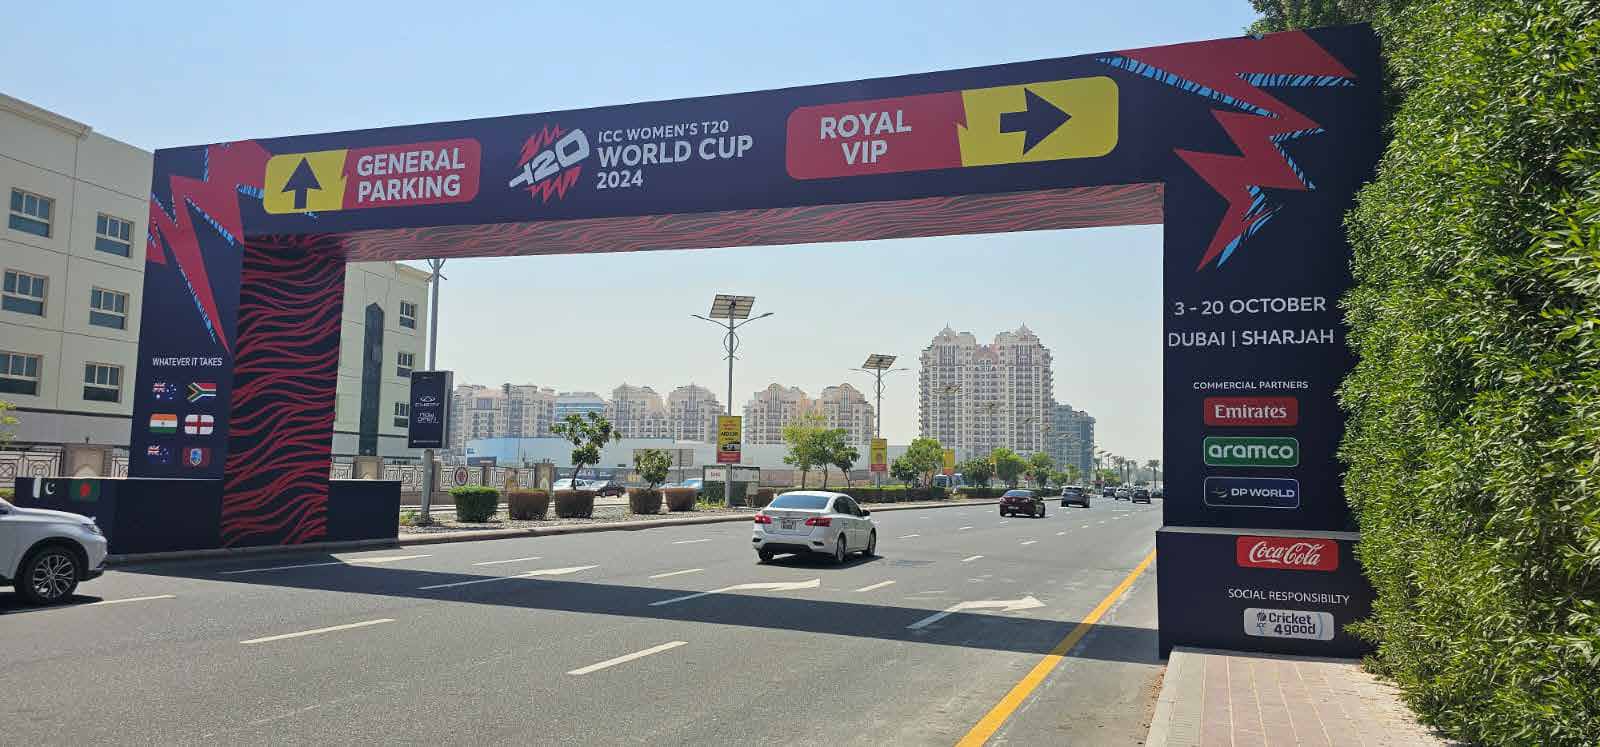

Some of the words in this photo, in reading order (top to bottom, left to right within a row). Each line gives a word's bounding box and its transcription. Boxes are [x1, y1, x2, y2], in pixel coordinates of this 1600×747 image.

[598, 130, 623, 143] ICC
[626, 122, 698, 141] WOMEN'S
[701, 120, 729, 134] T20
[819, 109, 912, 140] ROYAL
[597, 140, 692, 168] WORLD
[699, 135, 753, 161] CUP
[841, 139, 888, 165] VIP
[357, 147, 465, 176] GENERAL
[357, 174, 461, 203] PARKING
[596, 169, 644, 189] 2024
[1174, 302, 1185, 316] 3
[1201, 301, 1224, 315] 20
[1229, 296, 1327, 314] OCTOBER
[1168, 331, 1225, 347] DUBAI
[1241, 329, 1335, 345] SHARJAH
[152, 357, 190, 367] WHATEVER
[191, 357, 198, 367] IT
[199, 357, 223, 367] TAKES
[1193, 381, 1257, 390] COMMERCIAL
[1259, 381, 1309, 389] PARTNERS
[1215, 405, 1287, 419] Emirates
[1208, 444, 1294, 459] aramco
[1231, 488, 1248, 497] DP
[1249, 489, 1295, 498] WORLD
[1250, 541, 1325, 567] Coca-Cola
[1228, 588, 1266, 600] SOCIAL
[1269, 591, 1350, 606] RESPONSIBILTY
[1268, 612, 1312, 625] Cricket
[1274, 623, 1316, 636] 4good
